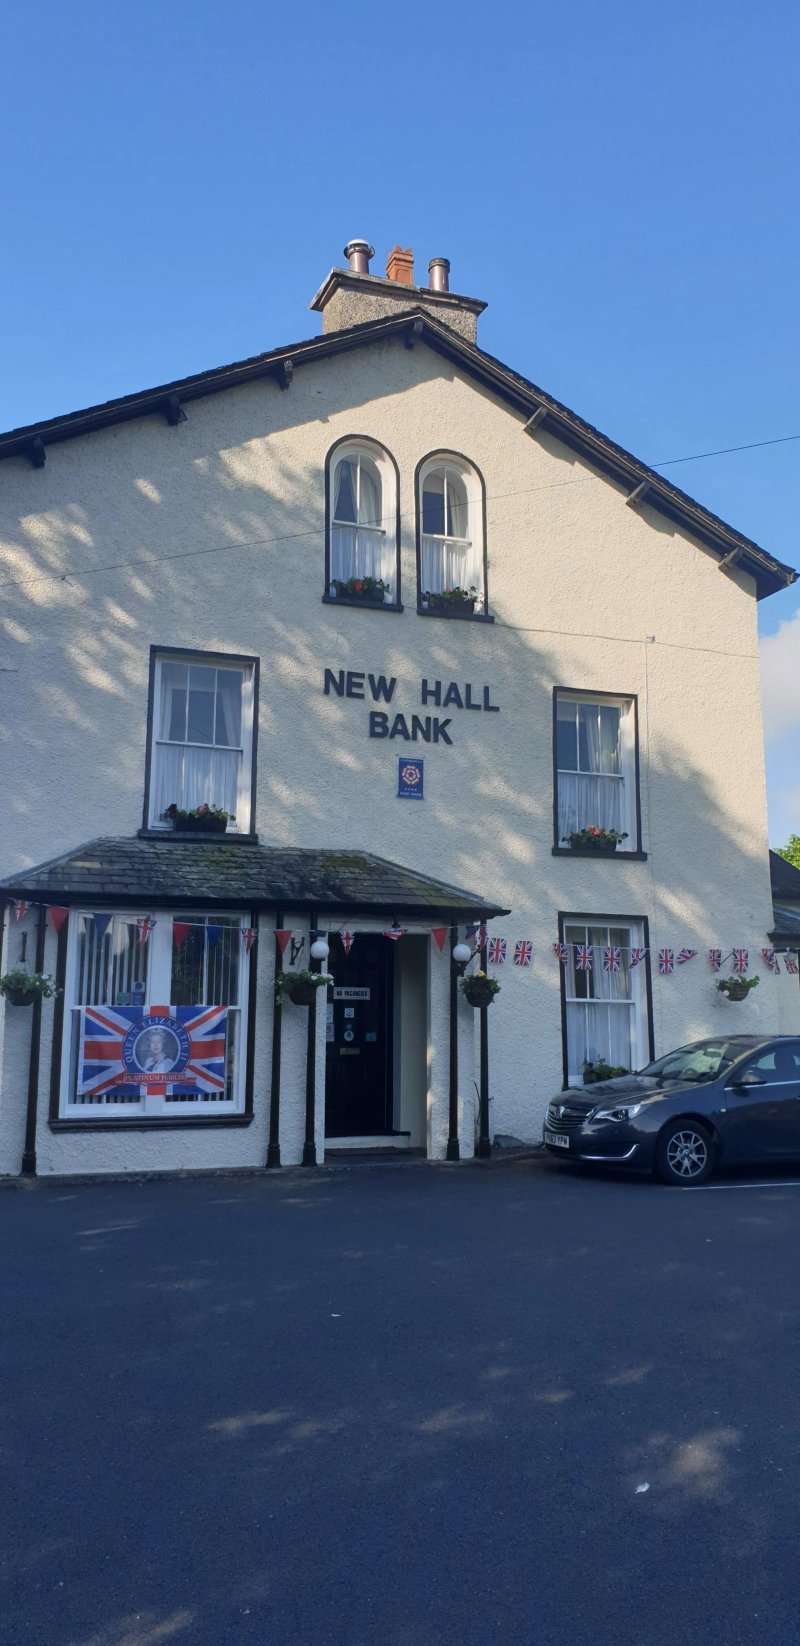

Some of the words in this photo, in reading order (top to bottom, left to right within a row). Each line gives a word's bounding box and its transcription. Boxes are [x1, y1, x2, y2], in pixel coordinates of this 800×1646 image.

[323, 668, 397, 703] NEW
[421, 678, 500, 712] HALL
[369, 710, 453, 745] BANK
[124, 1027, 140, 1063] QUEEN
[142, 1017, 189, 1048] ELIZABETH
